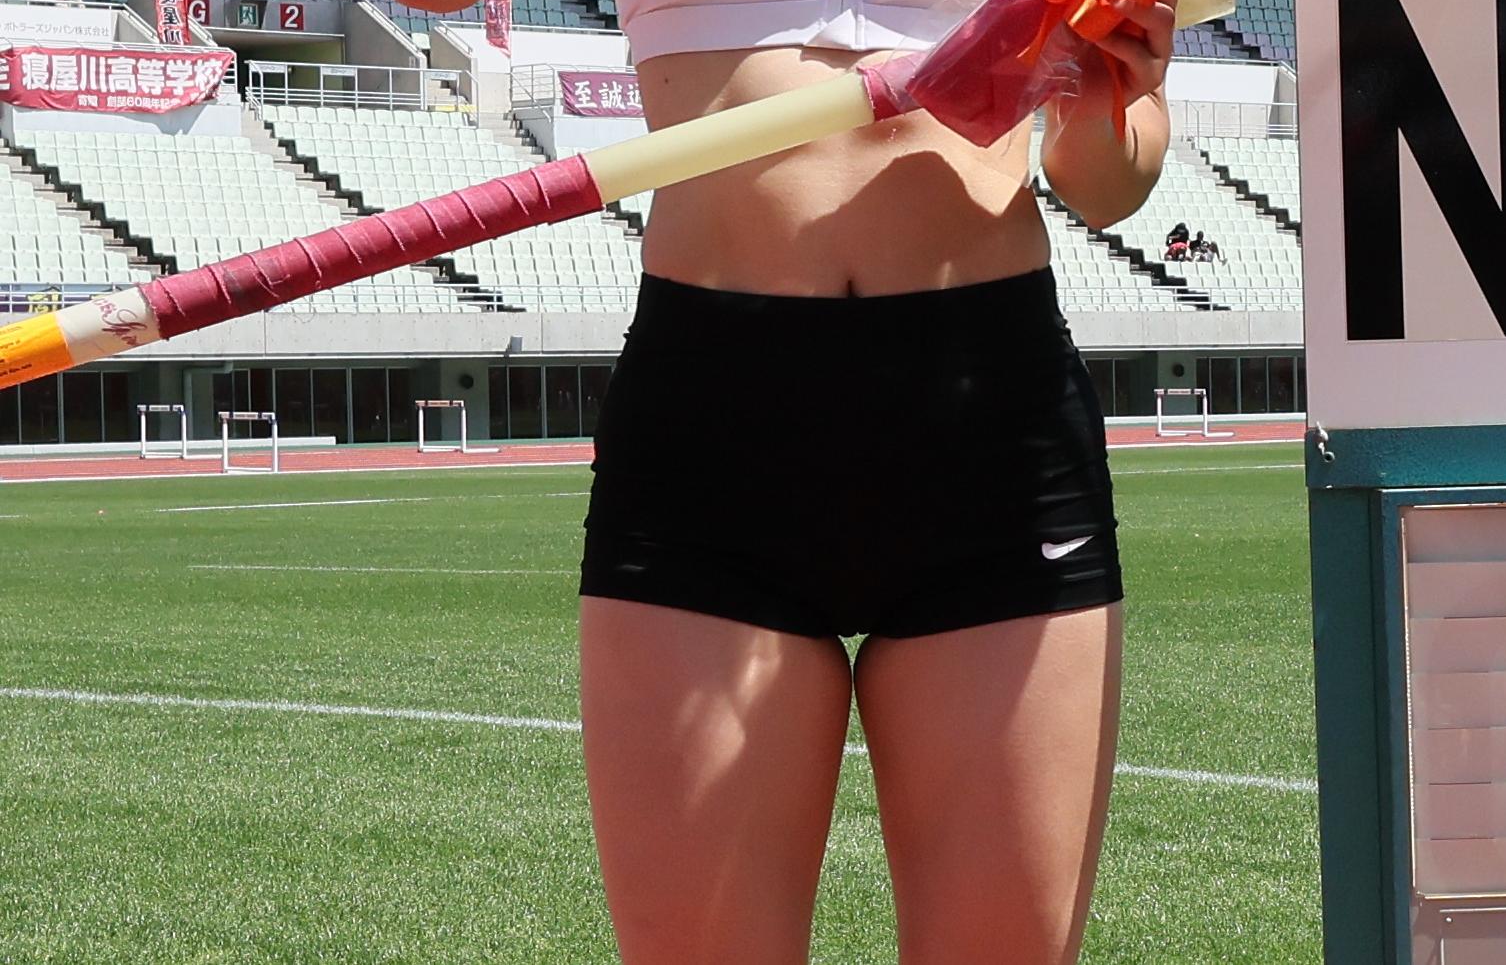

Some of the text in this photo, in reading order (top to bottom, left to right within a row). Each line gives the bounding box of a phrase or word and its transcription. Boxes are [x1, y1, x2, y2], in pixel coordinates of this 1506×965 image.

[189, 0, 206, 23] G
[284, 5, 299, 28] 2
[21, 52, 222, 95] 寝屋川高等学校
